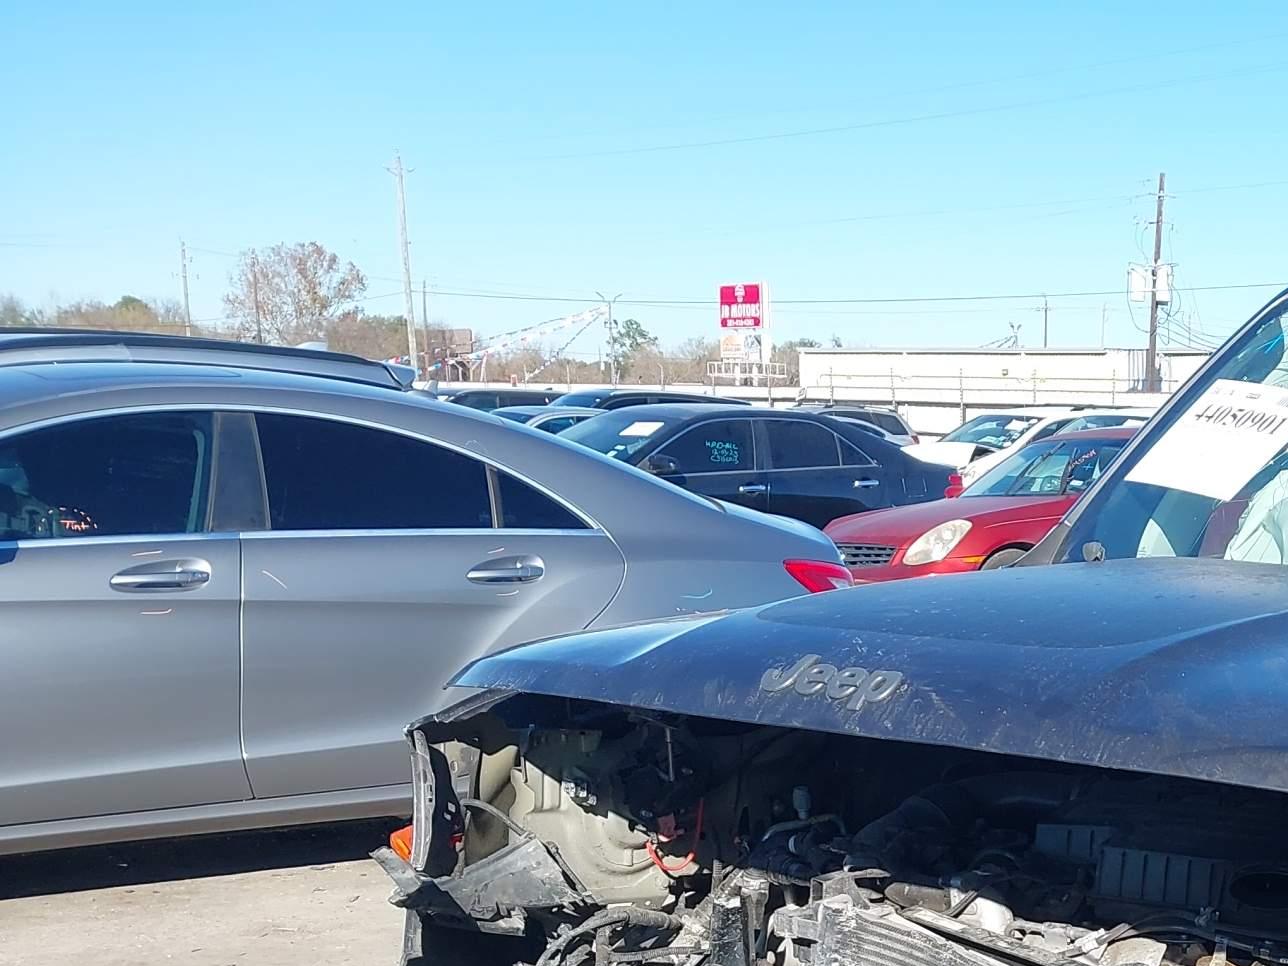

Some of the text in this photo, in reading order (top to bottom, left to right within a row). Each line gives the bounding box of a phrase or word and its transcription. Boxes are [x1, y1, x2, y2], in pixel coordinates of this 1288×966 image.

[731, 303, 760, 318] MOTORS
[1194, 403, 1288, 435] 44050901
[760, 653, 904, 711] Jeep
